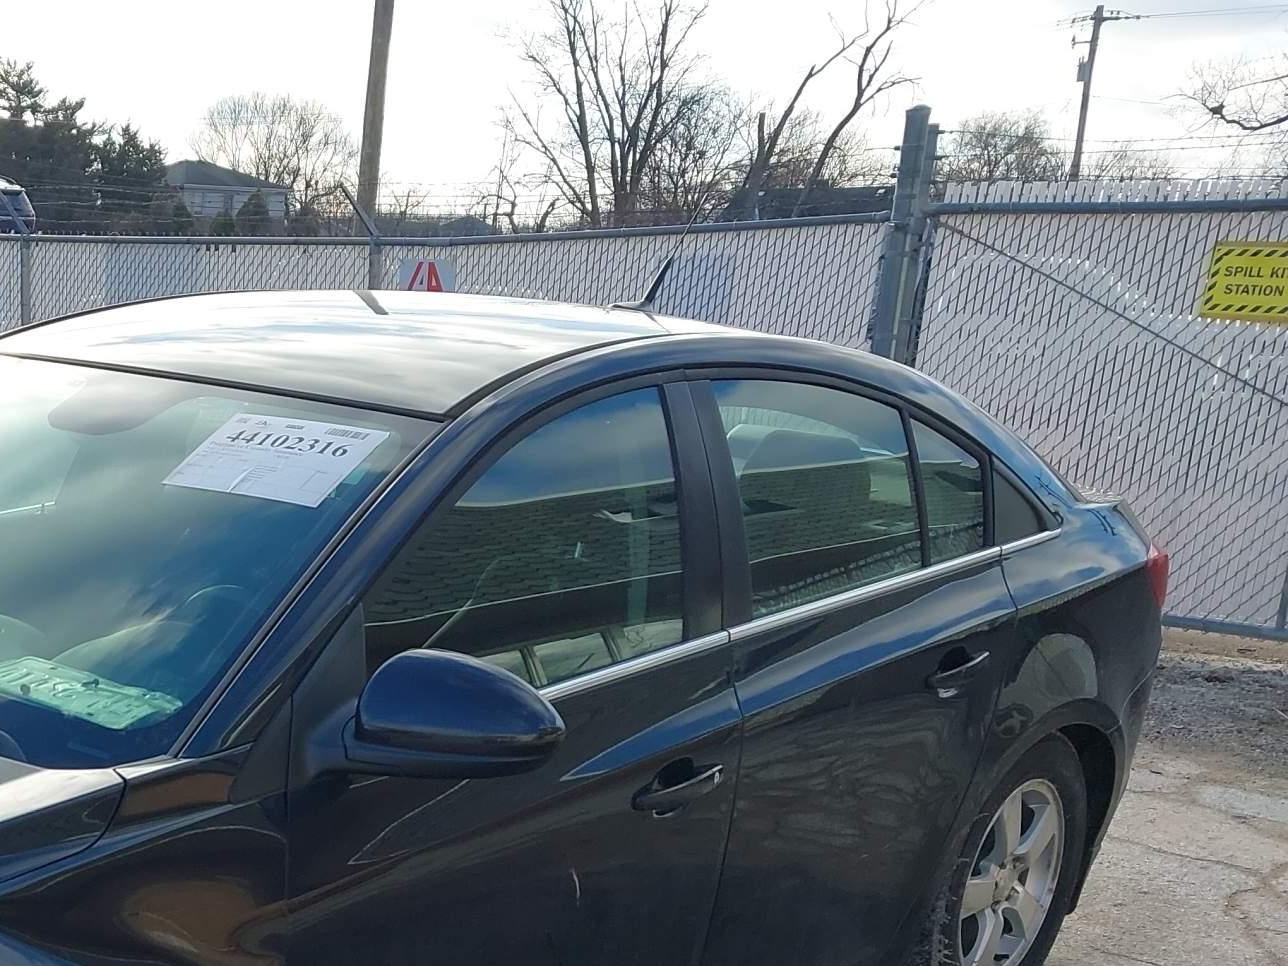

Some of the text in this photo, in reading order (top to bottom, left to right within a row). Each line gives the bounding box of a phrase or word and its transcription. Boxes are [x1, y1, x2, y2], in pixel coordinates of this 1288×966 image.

[1223, 265, 1288, 279] SPILL KI
[1223, 283, 1285, 297] STATION
[225, 429, 353, 458] 44102316
